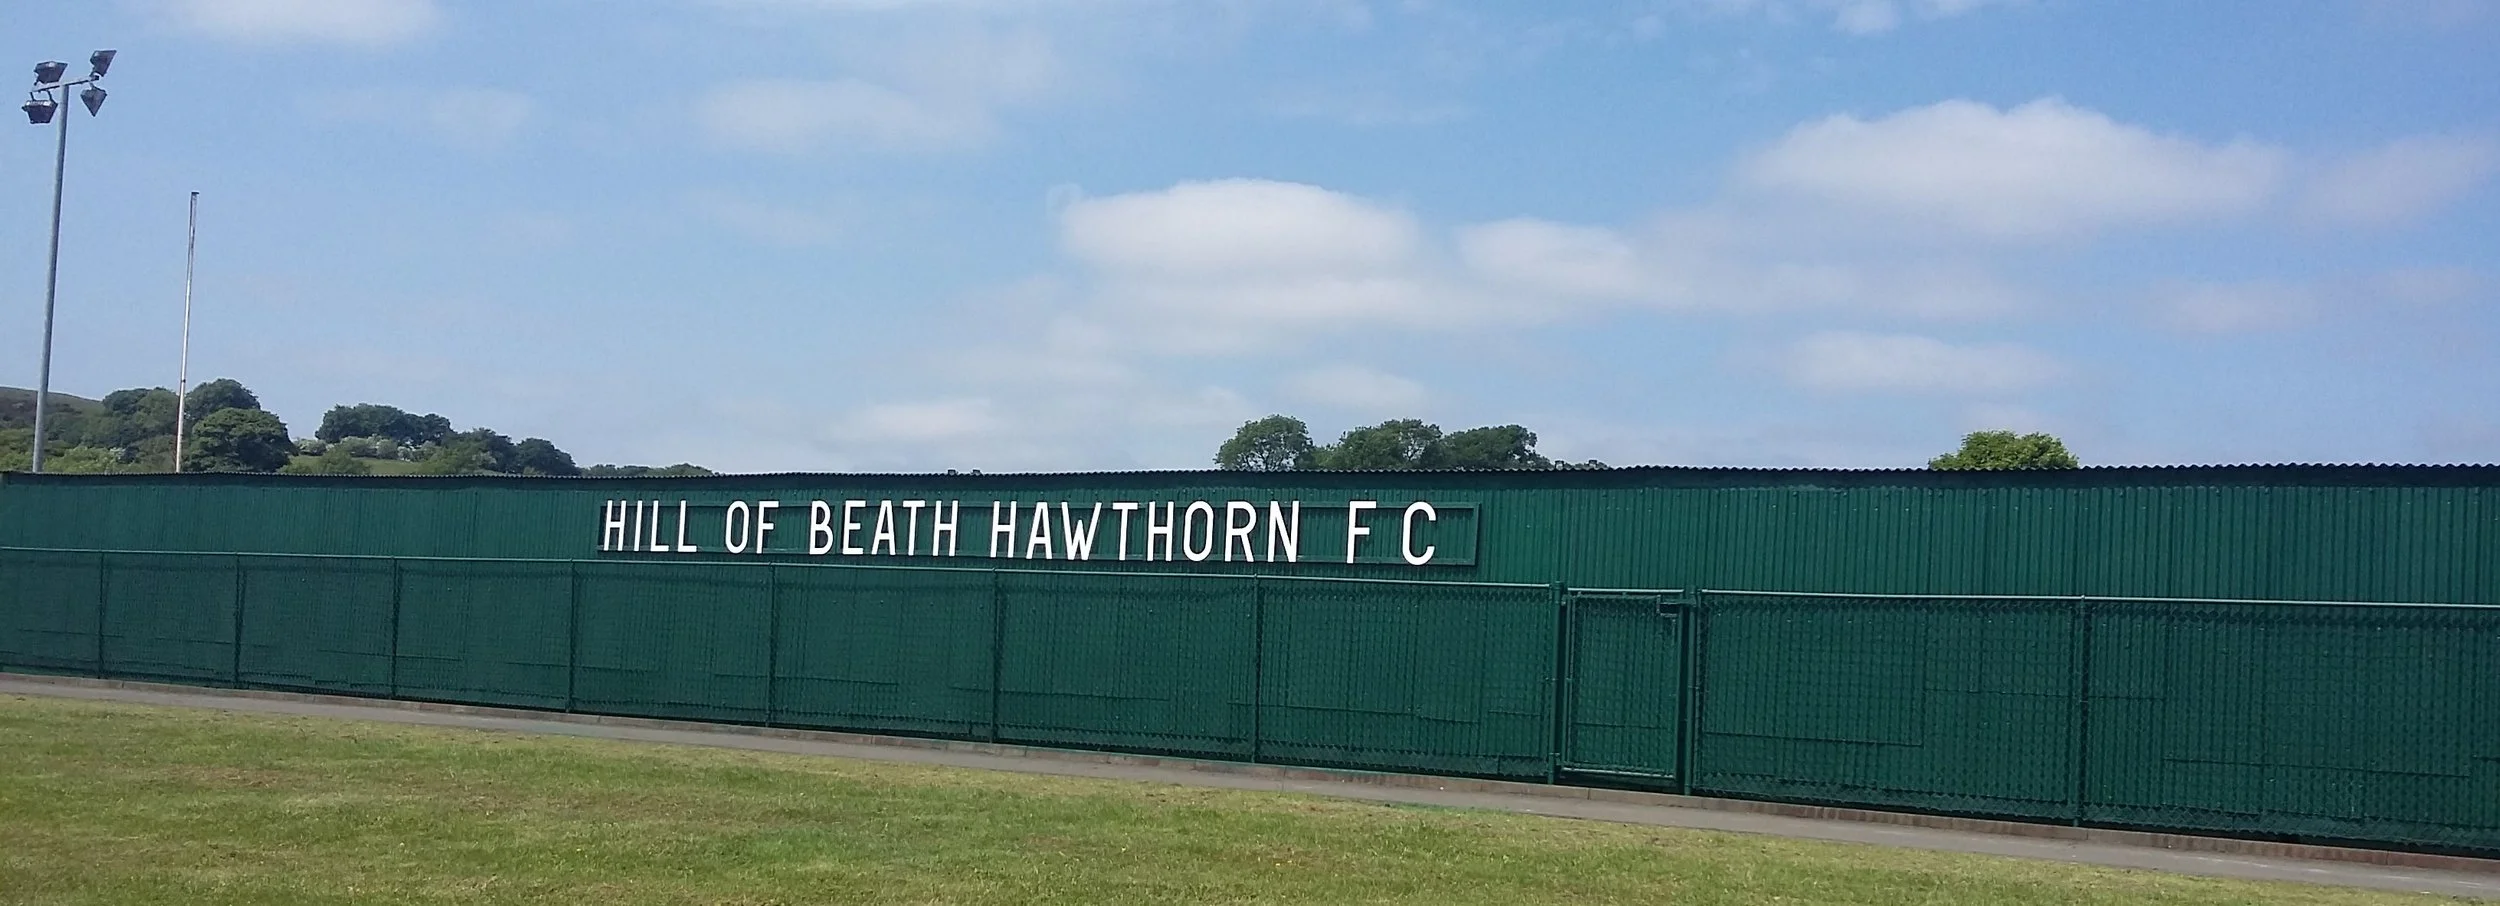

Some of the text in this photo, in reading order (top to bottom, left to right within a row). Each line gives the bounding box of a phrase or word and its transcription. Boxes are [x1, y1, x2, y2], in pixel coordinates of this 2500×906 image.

[603, 499, 698, 553] HILL
[725, 500, 779, 554] OF
[808, 499, 959, 557] BEATH
[990, 500, 1300, 564] HAWTHORN
